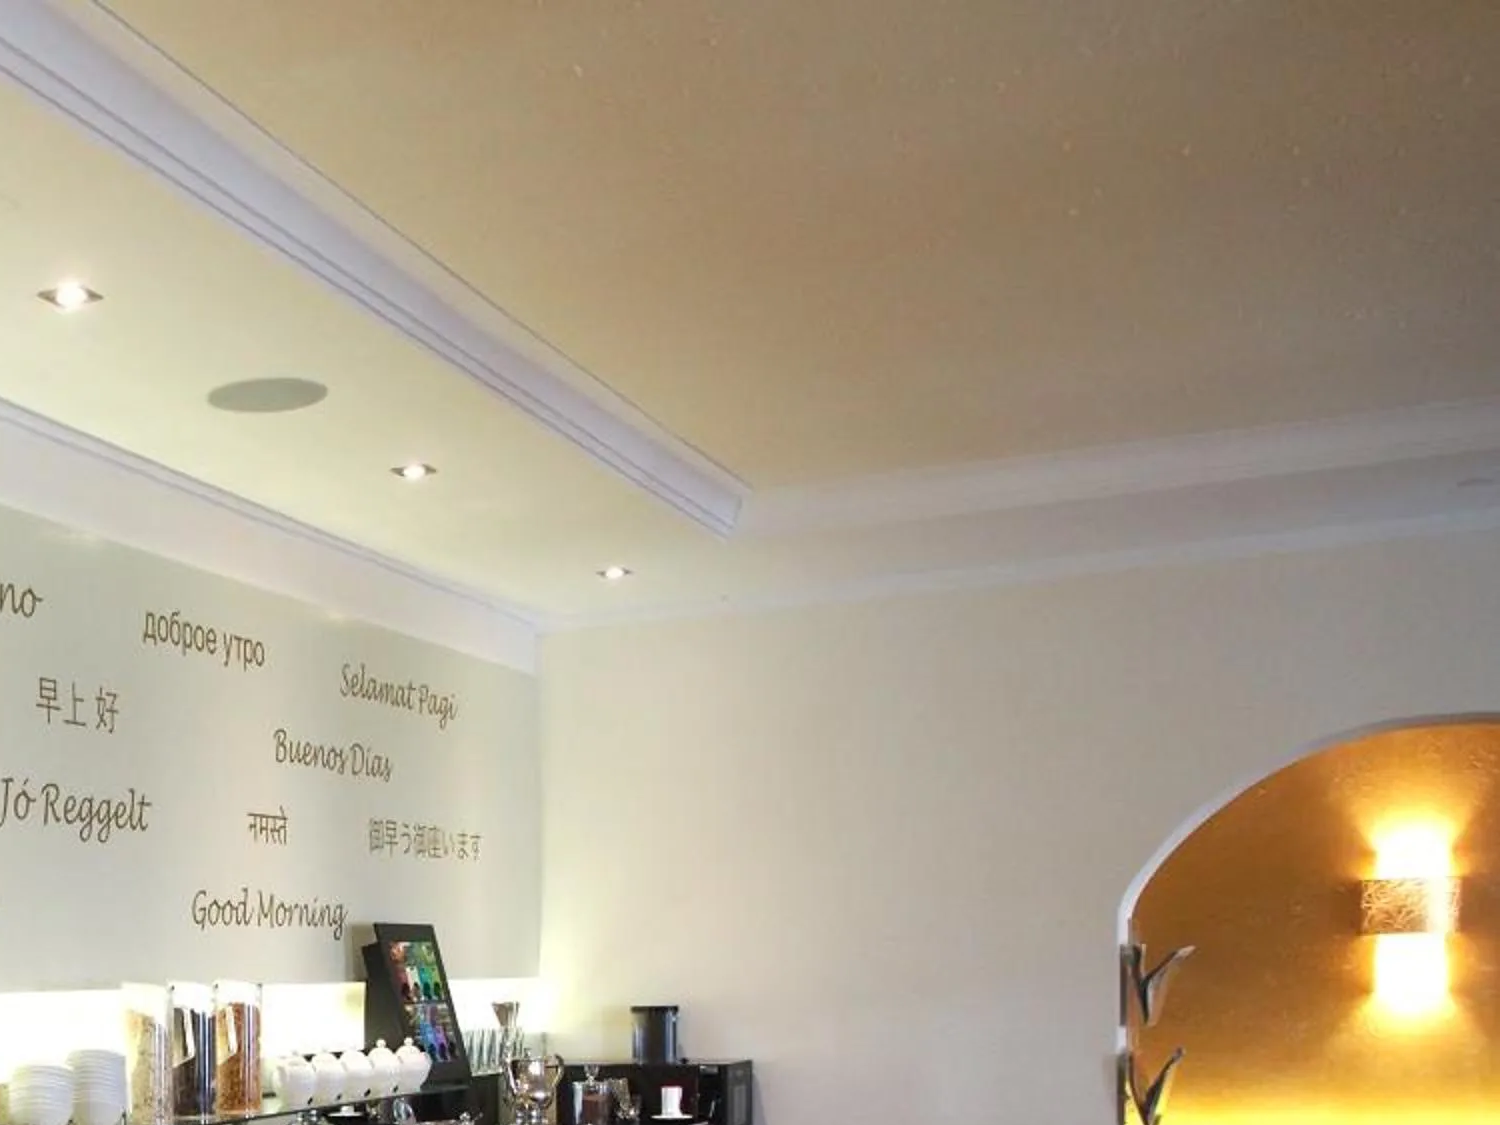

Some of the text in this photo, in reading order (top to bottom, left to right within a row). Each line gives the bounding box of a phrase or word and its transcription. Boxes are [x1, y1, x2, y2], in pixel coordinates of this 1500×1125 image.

[142, 610, 266, 672] доброе утро
[35, 676, 120, 735] 早上好
[339, 662, 457, 730] Selamat Pagi
[272, 727, 348, 776] Buenos
[39, 782, 153, 844] Reggelt
[246, 805, 289, 845] नमस्ते
[191, 887, 349, 941] Good Morning
